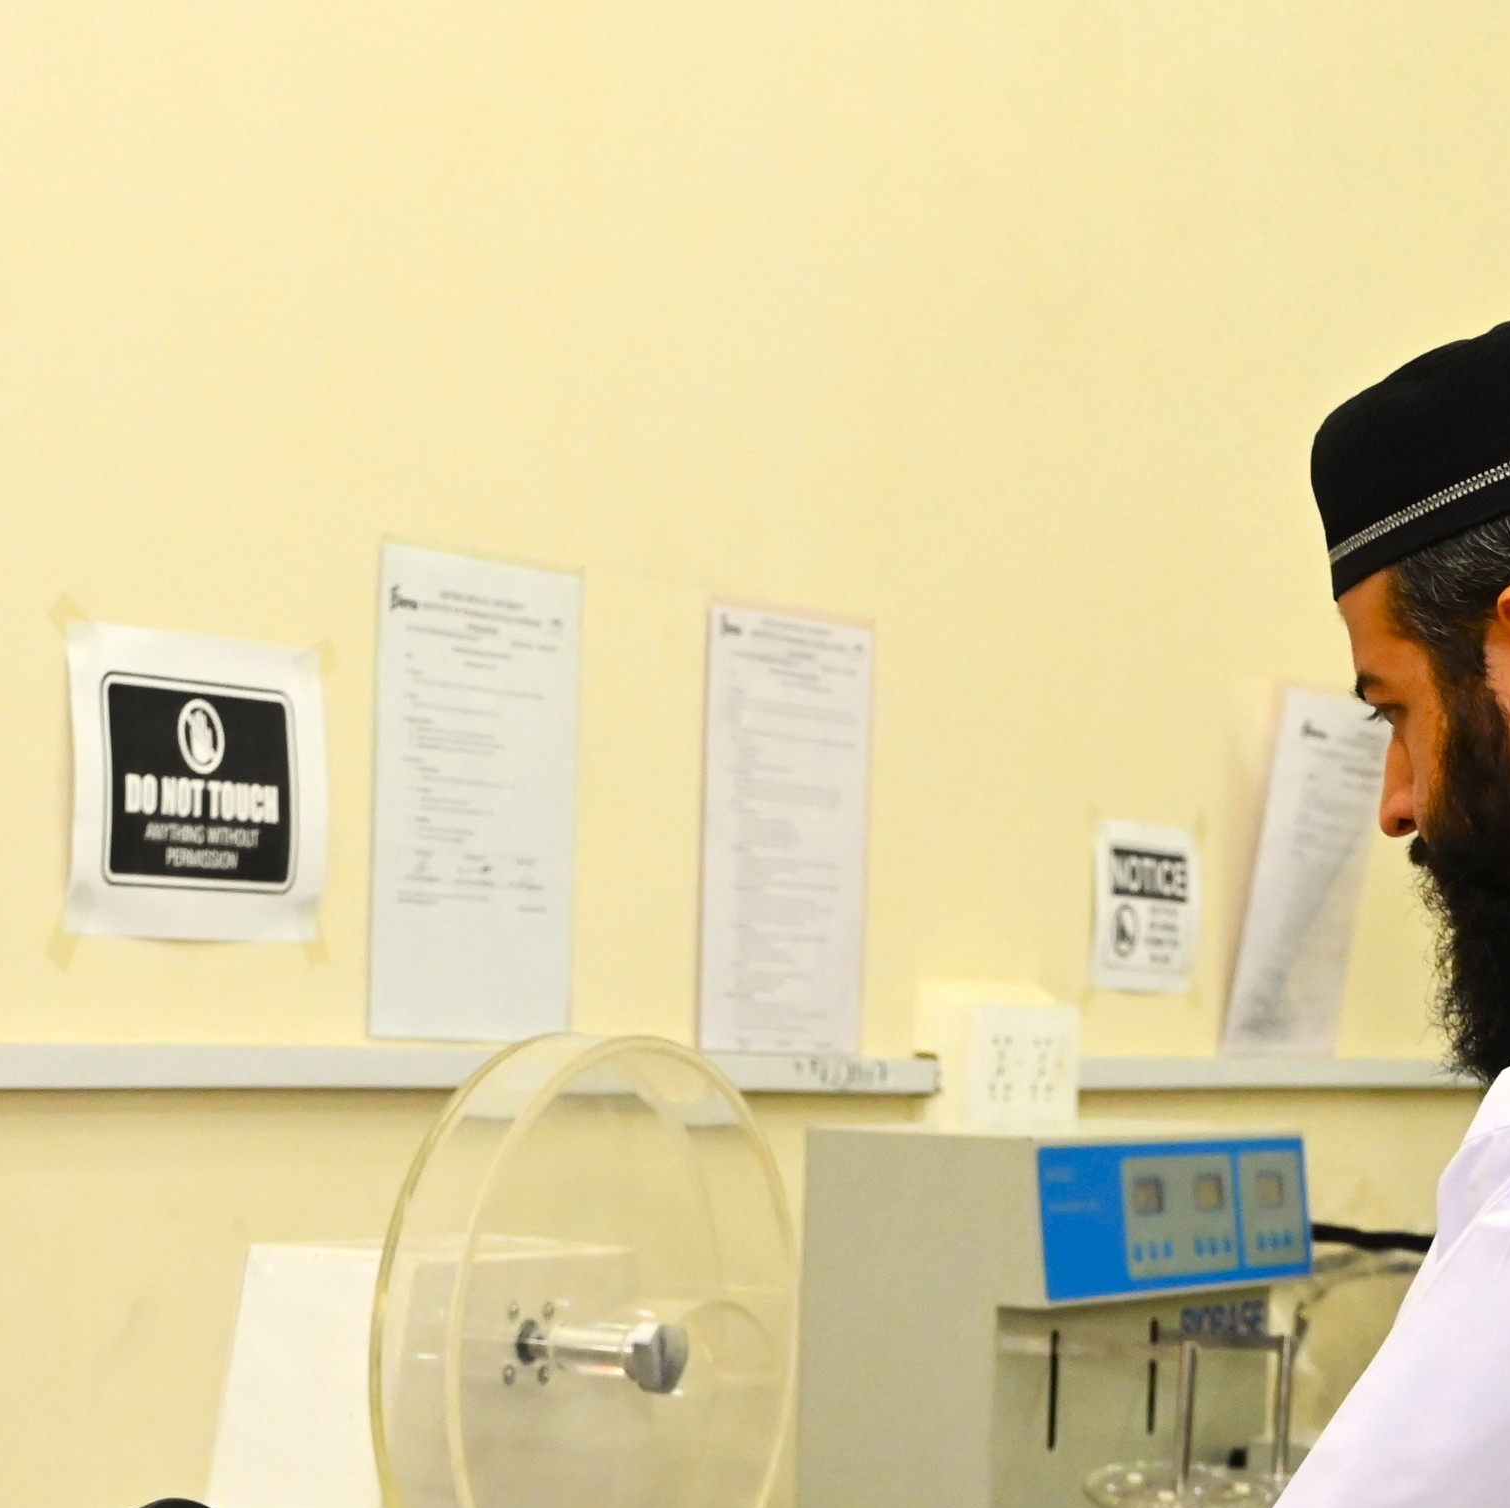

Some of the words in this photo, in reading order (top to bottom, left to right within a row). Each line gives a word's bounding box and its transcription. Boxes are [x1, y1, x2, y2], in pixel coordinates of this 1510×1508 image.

[124, 772, 158, 815] DO
[160, 775, 205, 818] NOT
[206, 780, 280, 824] TOUCH
[143, 821, 206, 845] ANYTHING
[207, 826, 260, 849] WITHOUT
[164, 846, 239, 870] PERMISSION
[1109, 855, 1187, 897] NOTICE
